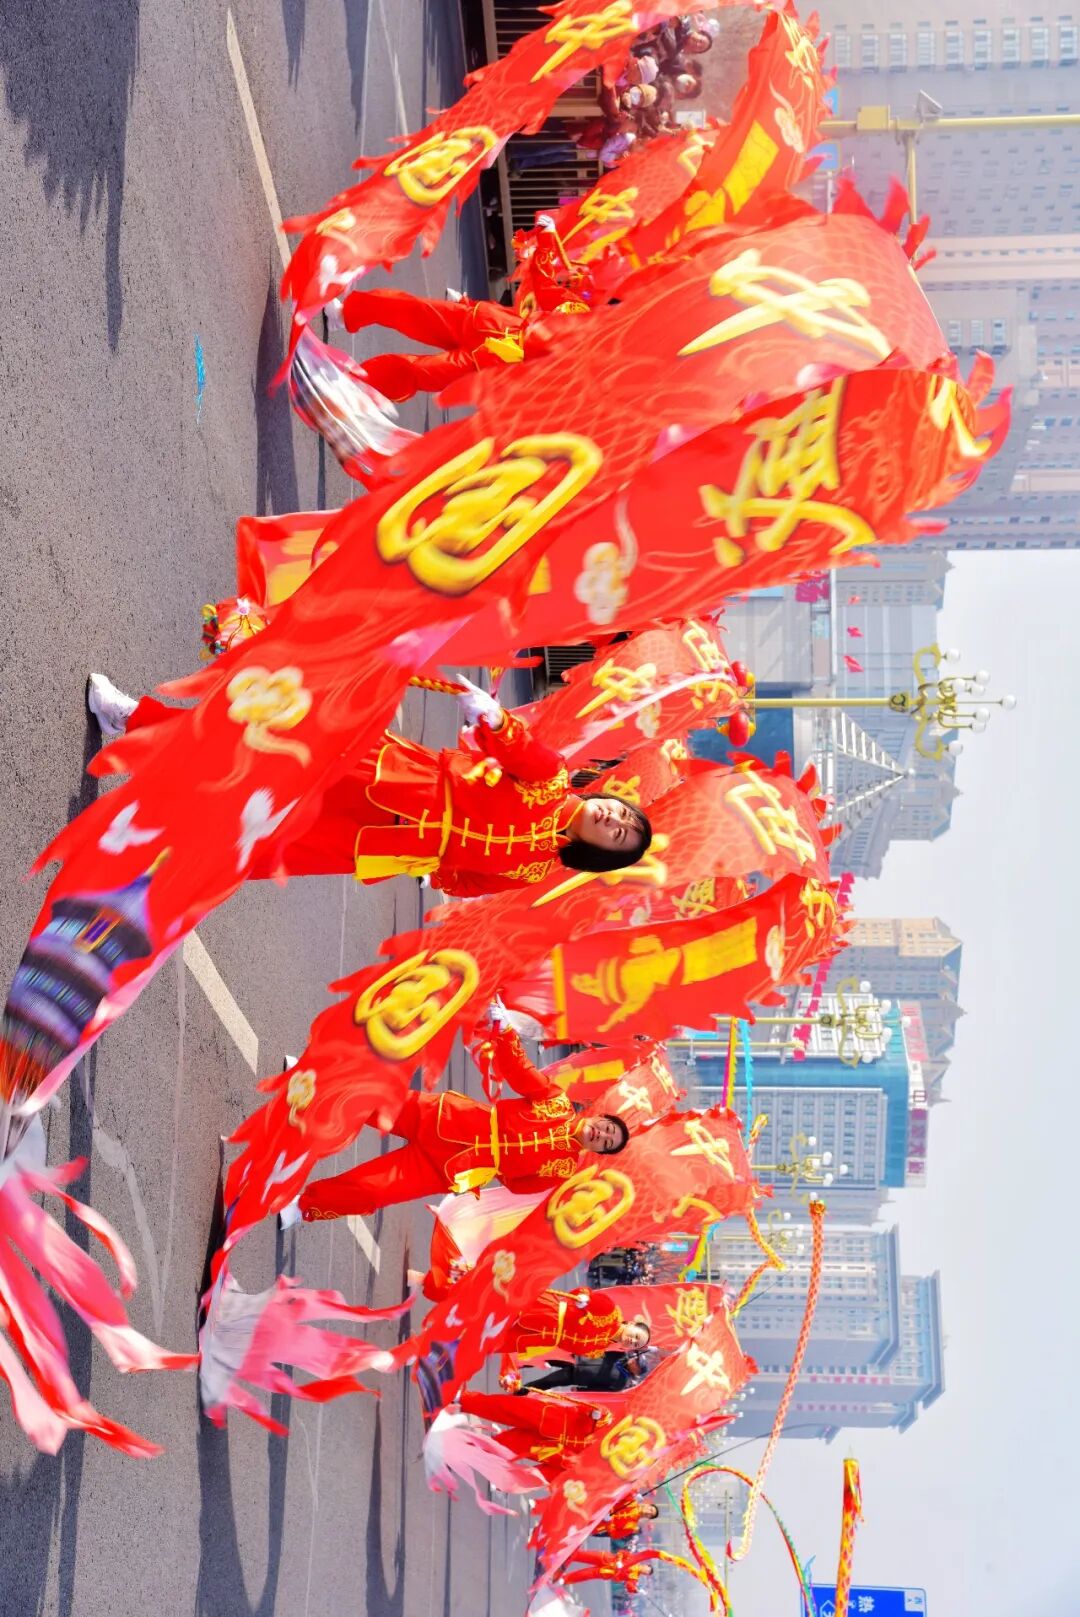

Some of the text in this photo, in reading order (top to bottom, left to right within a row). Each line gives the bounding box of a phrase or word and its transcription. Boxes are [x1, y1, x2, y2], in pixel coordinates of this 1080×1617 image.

[677, 248, 892, 358] 中
[376, 431, 605, 598] 国
[353, 948, 480, 1061] 国
[546, 1119, 735, 1250] 中 国
[679, 1343, 731, 1396] 中
